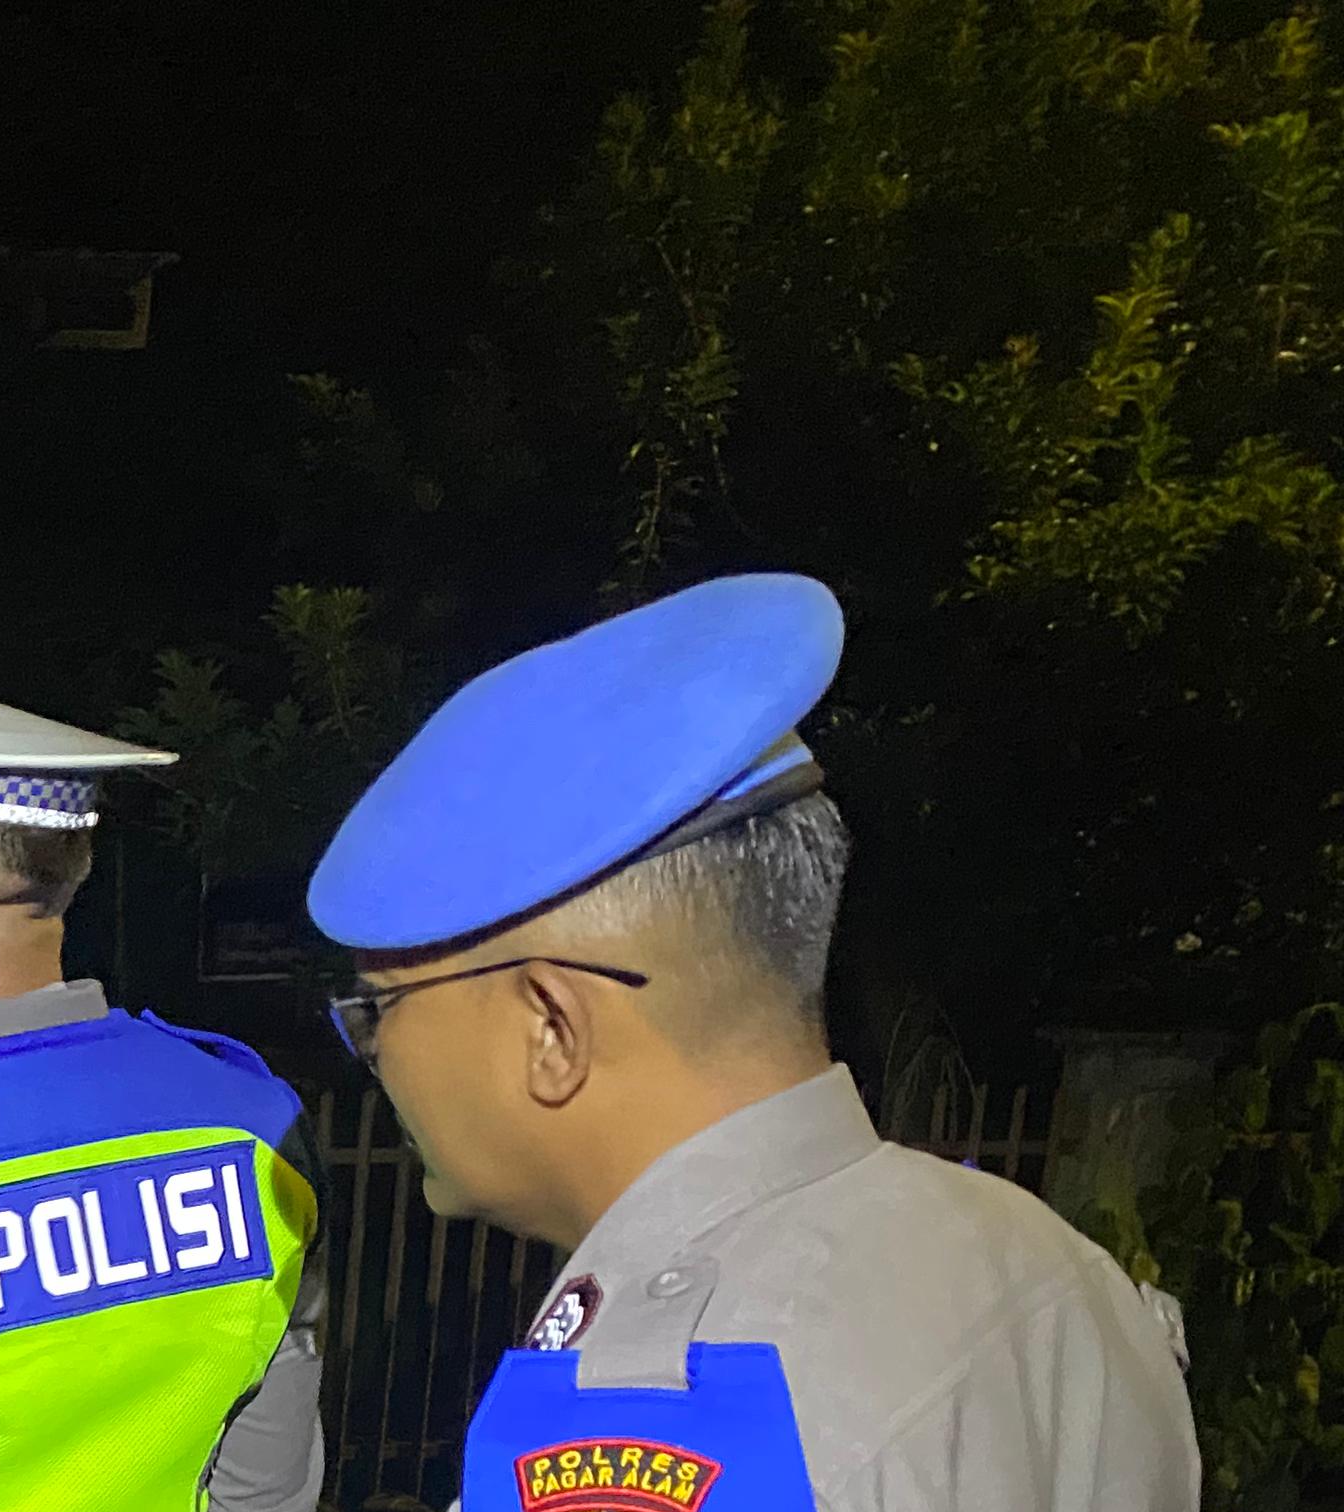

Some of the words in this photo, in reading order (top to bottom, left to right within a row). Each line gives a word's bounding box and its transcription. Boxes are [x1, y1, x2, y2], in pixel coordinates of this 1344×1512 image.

[534, 1446, 700, 1481] POLRES
[532, 1466, 614, 1498] PAGAR
[622, 1467, 695, 1504] ALAM
